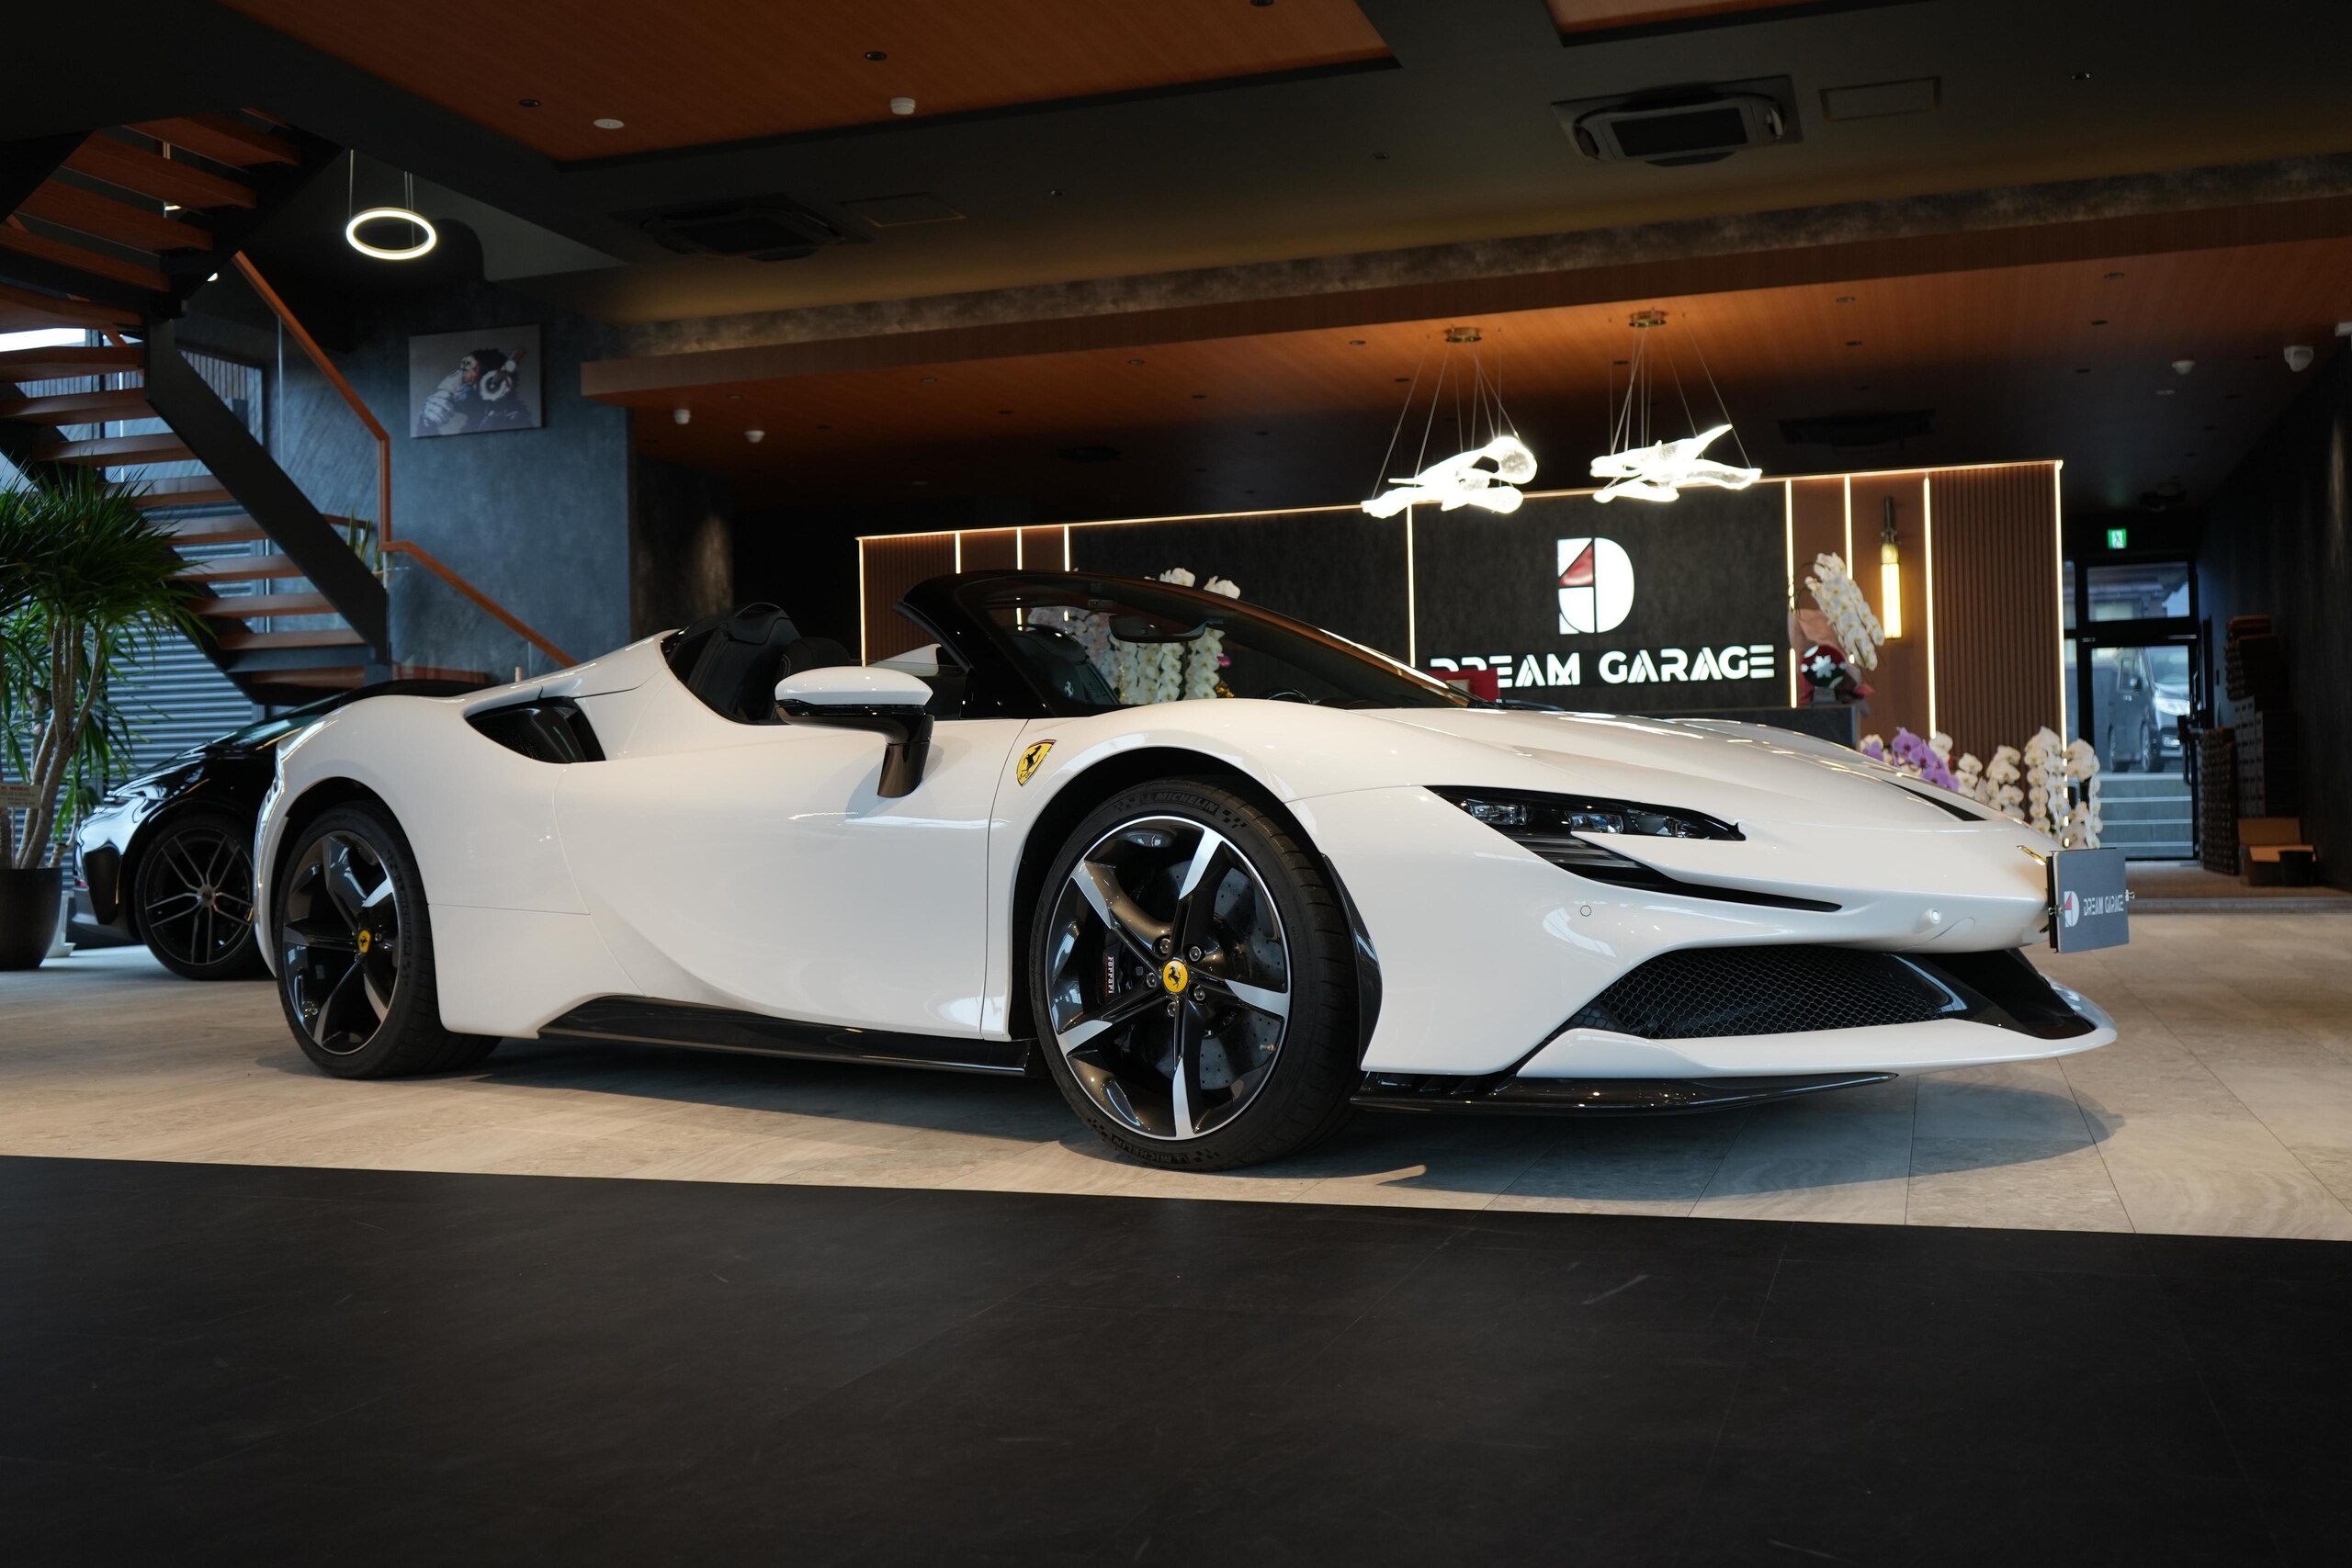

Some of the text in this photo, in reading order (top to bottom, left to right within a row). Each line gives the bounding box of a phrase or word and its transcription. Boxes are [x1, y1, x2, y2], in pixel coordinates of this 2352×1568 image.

[1599, 645, 1775, 683] GARAGE
[1155, 792, 1219, 814] MICHELIN
[2083, 895, 2124, 916] DREAM GARAGE
[1107, 955, 1115, 994] Ferrari
